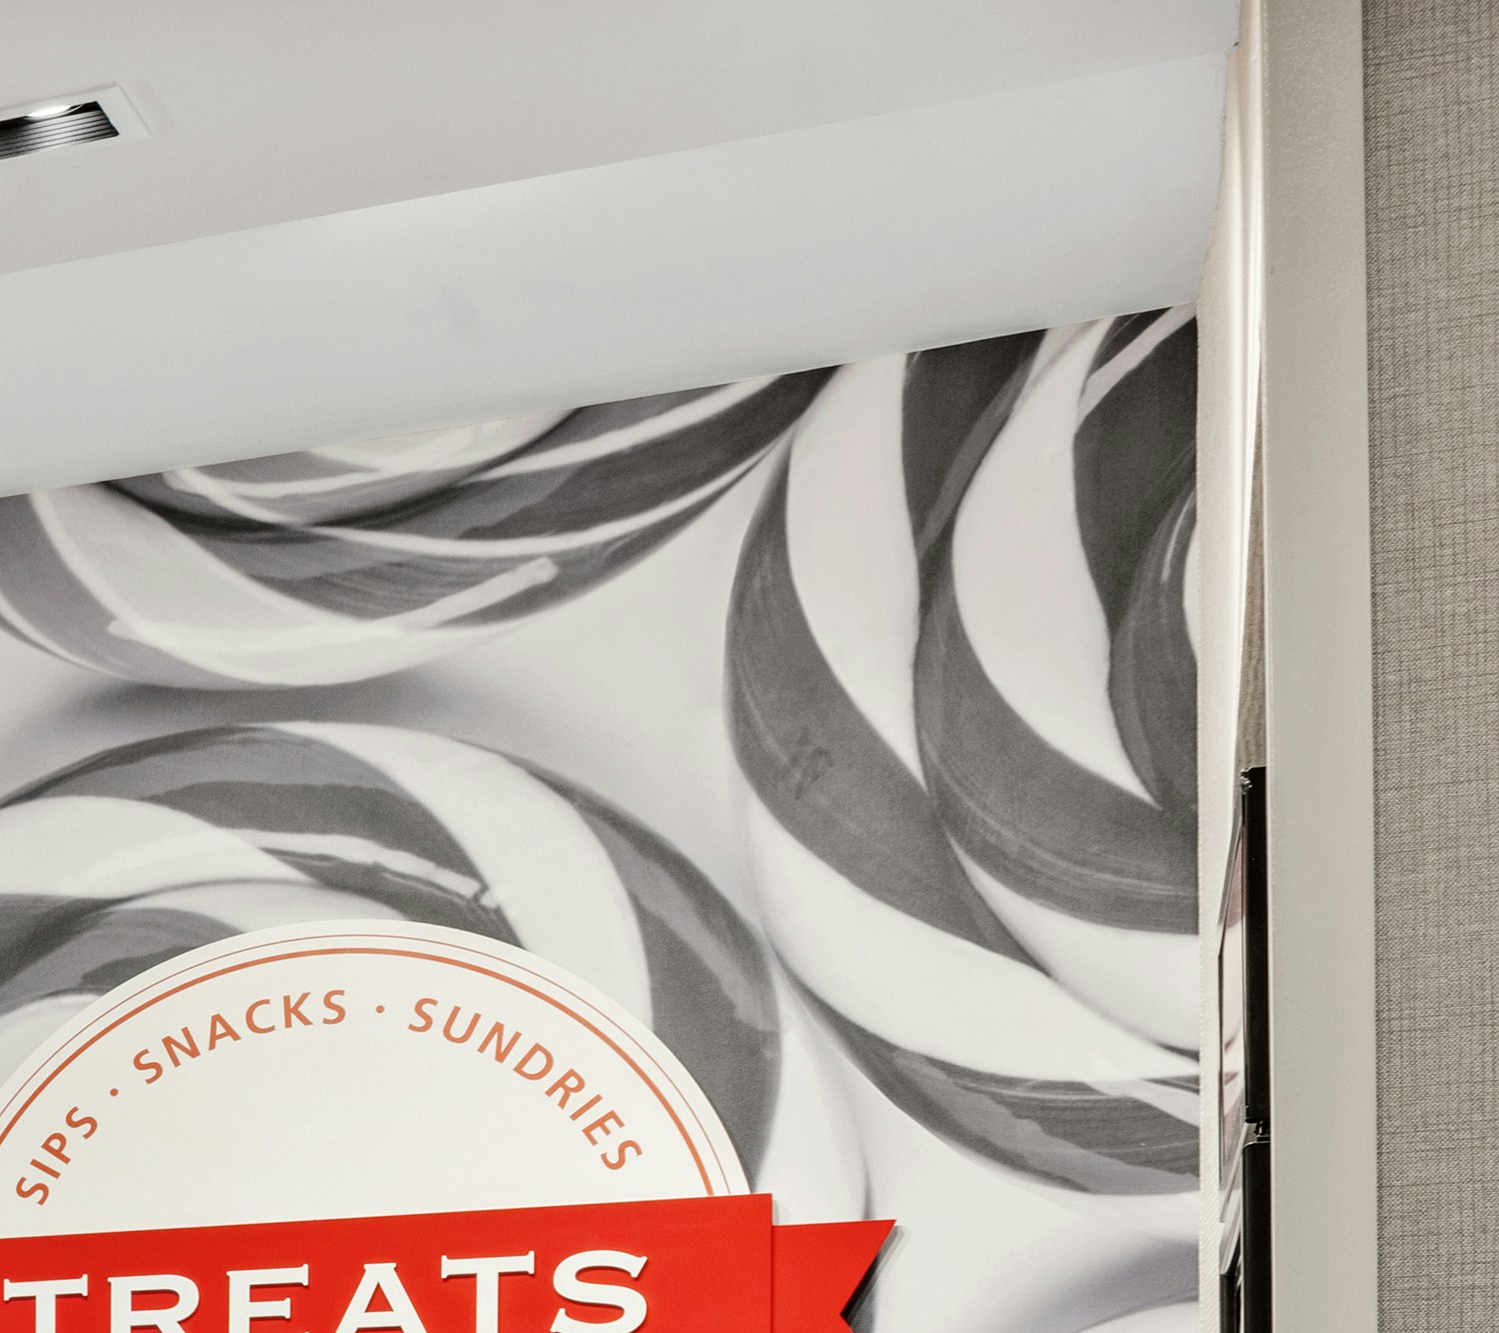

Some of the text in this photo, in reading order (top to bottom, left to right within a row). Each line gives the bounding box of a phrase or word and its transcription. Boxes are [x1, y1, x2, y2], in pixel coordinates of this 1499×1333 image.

[14, 988, 644, 1206] SIPS SNACKS SUNDRIES
